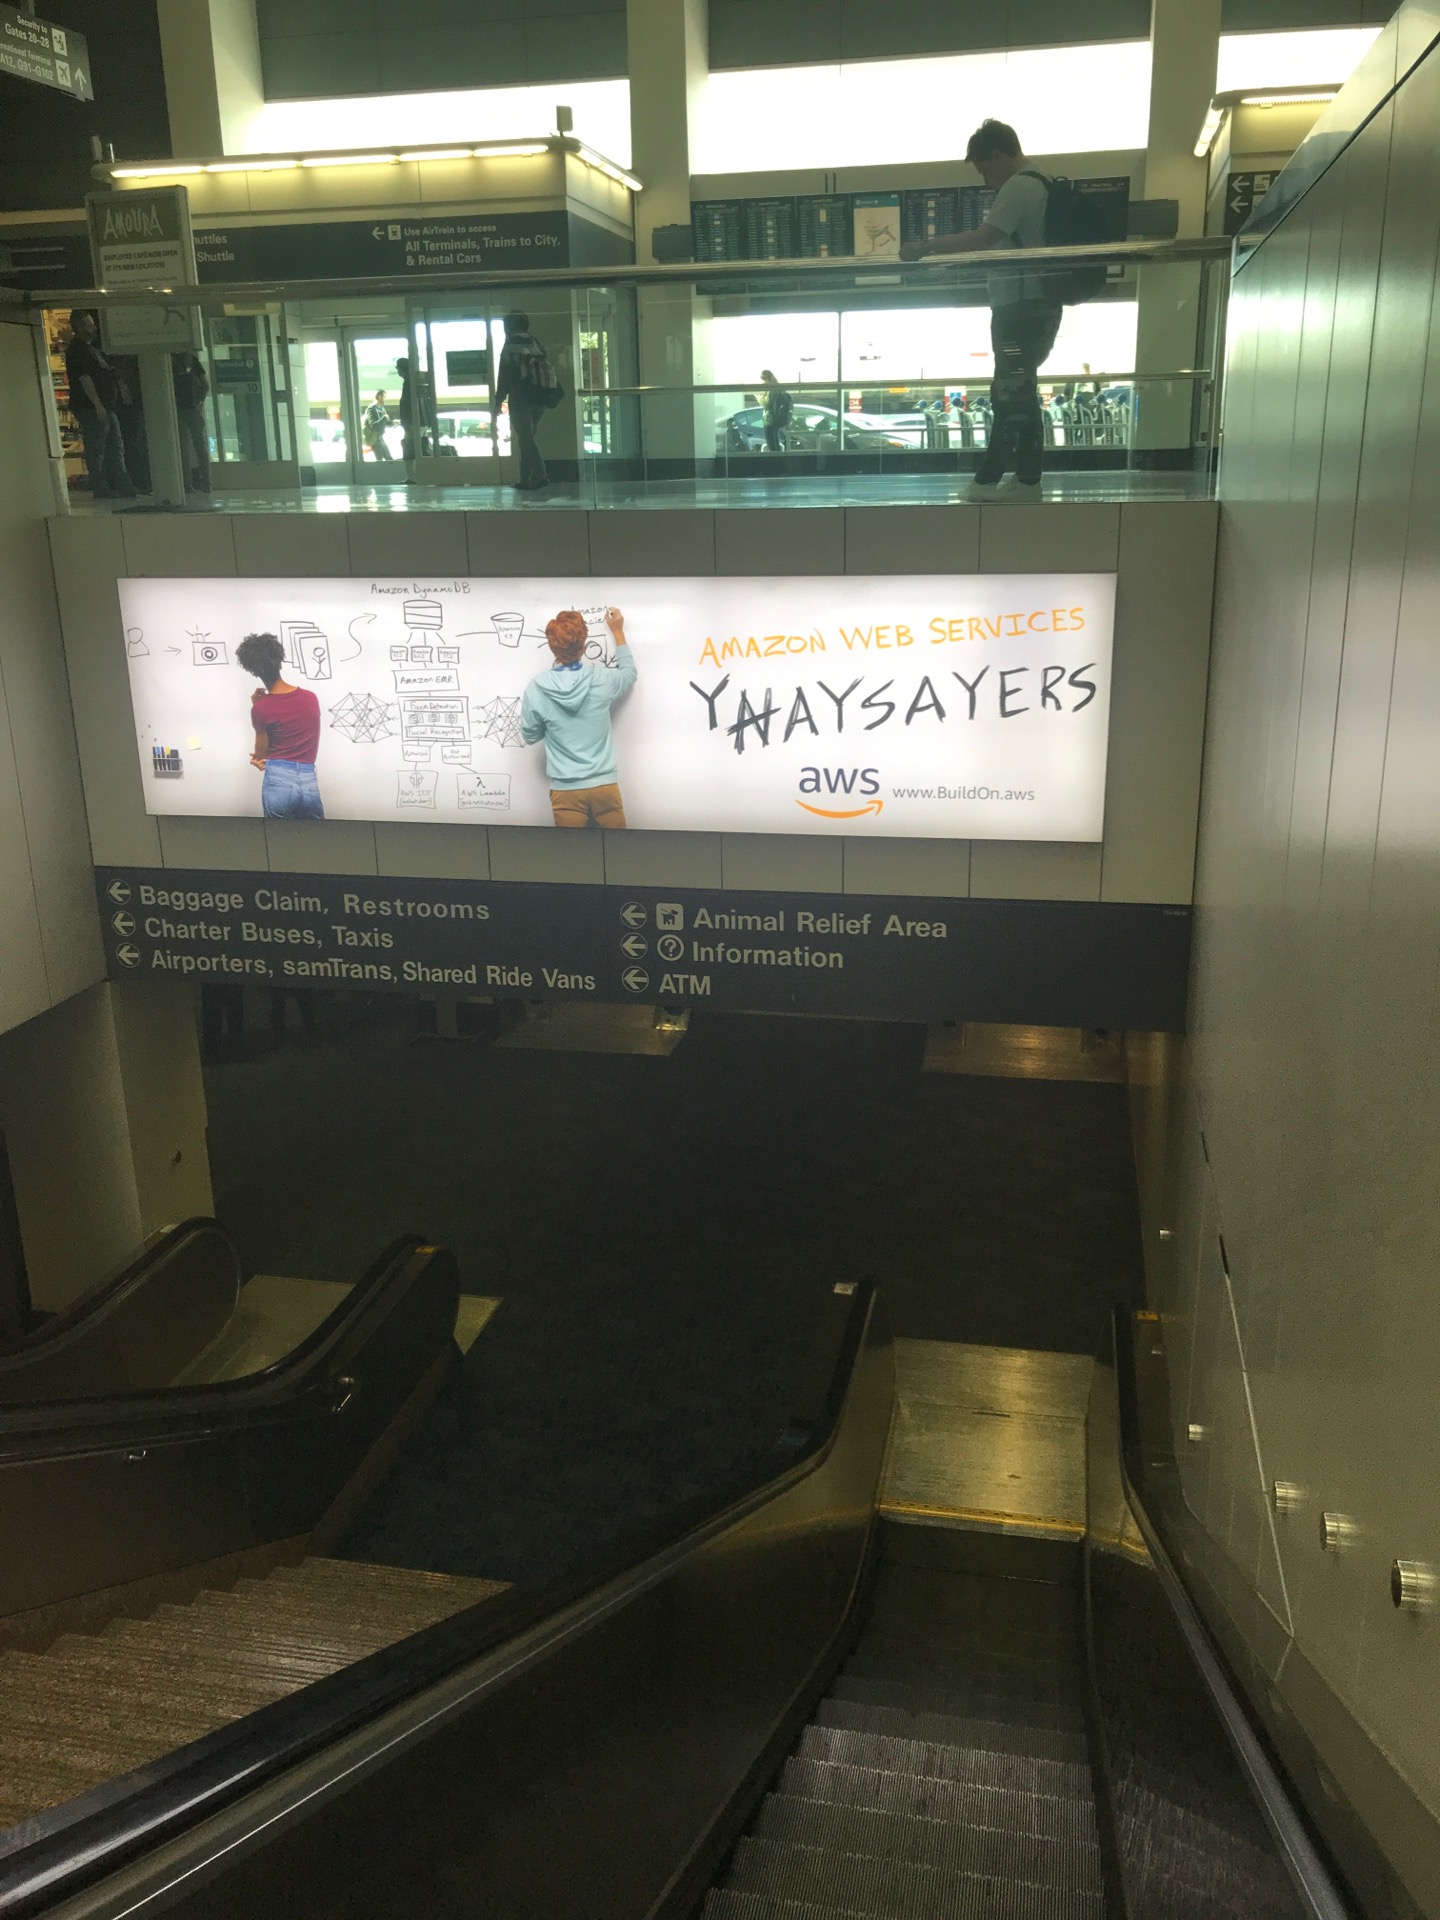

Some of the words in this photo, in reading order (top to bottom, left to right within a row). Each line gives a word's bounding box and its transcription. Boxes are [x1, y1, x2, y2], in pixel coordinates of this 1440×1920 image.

[5, 23, 27, 40] Gates
[17, 15, 40, 32] Security
[41, 26, 48, 34] to
[27, 50, 52, 66] Terminal
[104, 204, 166, 240] AMOURA
[404, 228, 420, 236] Use
[422, 226, 455, 236] AirTrain
[457, 226, 466, 234] to
[468, 224, 496, 233] access
[192, 234, 228, 247] huttles
[406, 240, 420, 252] All
[423, 238, 480, 252] Terminals,
[483, 236, 516, 248] Trains
[520, 236, 532, 246] to
[534, 234, 560, 248] City,
[197, 250, 235, 262] Shuttle
[406, 256, 415, 266] &
[418, 254, 453, 266] Rental
[456, 253, 482, 264] Cars
[371, 584, 410, 595] Amazon
[413, 582, 471, 598] DynamoDB
[699, 627, 826, 669] AMAZON
[839, 624, 914, 650] WEB
[928, 607, 1086, 644] SERVICES
[400, 676, 434, 684] Amazon
[435, 675, 454, 684] EMR
[798, 764, 880, 796] aws
[892, 786, 1035, 802] www.BuildOn.aws
[139, 884, 245, 912] Baggage
[254, 888, 328, 916] Claim,
[344, 894, 490, 921] Restrooms
[693, 908, 784, 933] Animal
[797, 910, 872, 935] Relief
[884, 915, 948, 938] Area
[144, 917, 232, 942] Charter
[242, 922, 323, 950] Buses,
[332, 925, 394, 950] Taxis
[692, 942, 844, 969] Information
[151, 950, 273, 977] Airporters,
[283, 958, 398, 982] samTrans,
[403, 962, 477, 985] Shared
[486, 965, 533, 988] Ride
[542, 968, 596, 991] Vans
[658, 974, 712, 996] ATM
